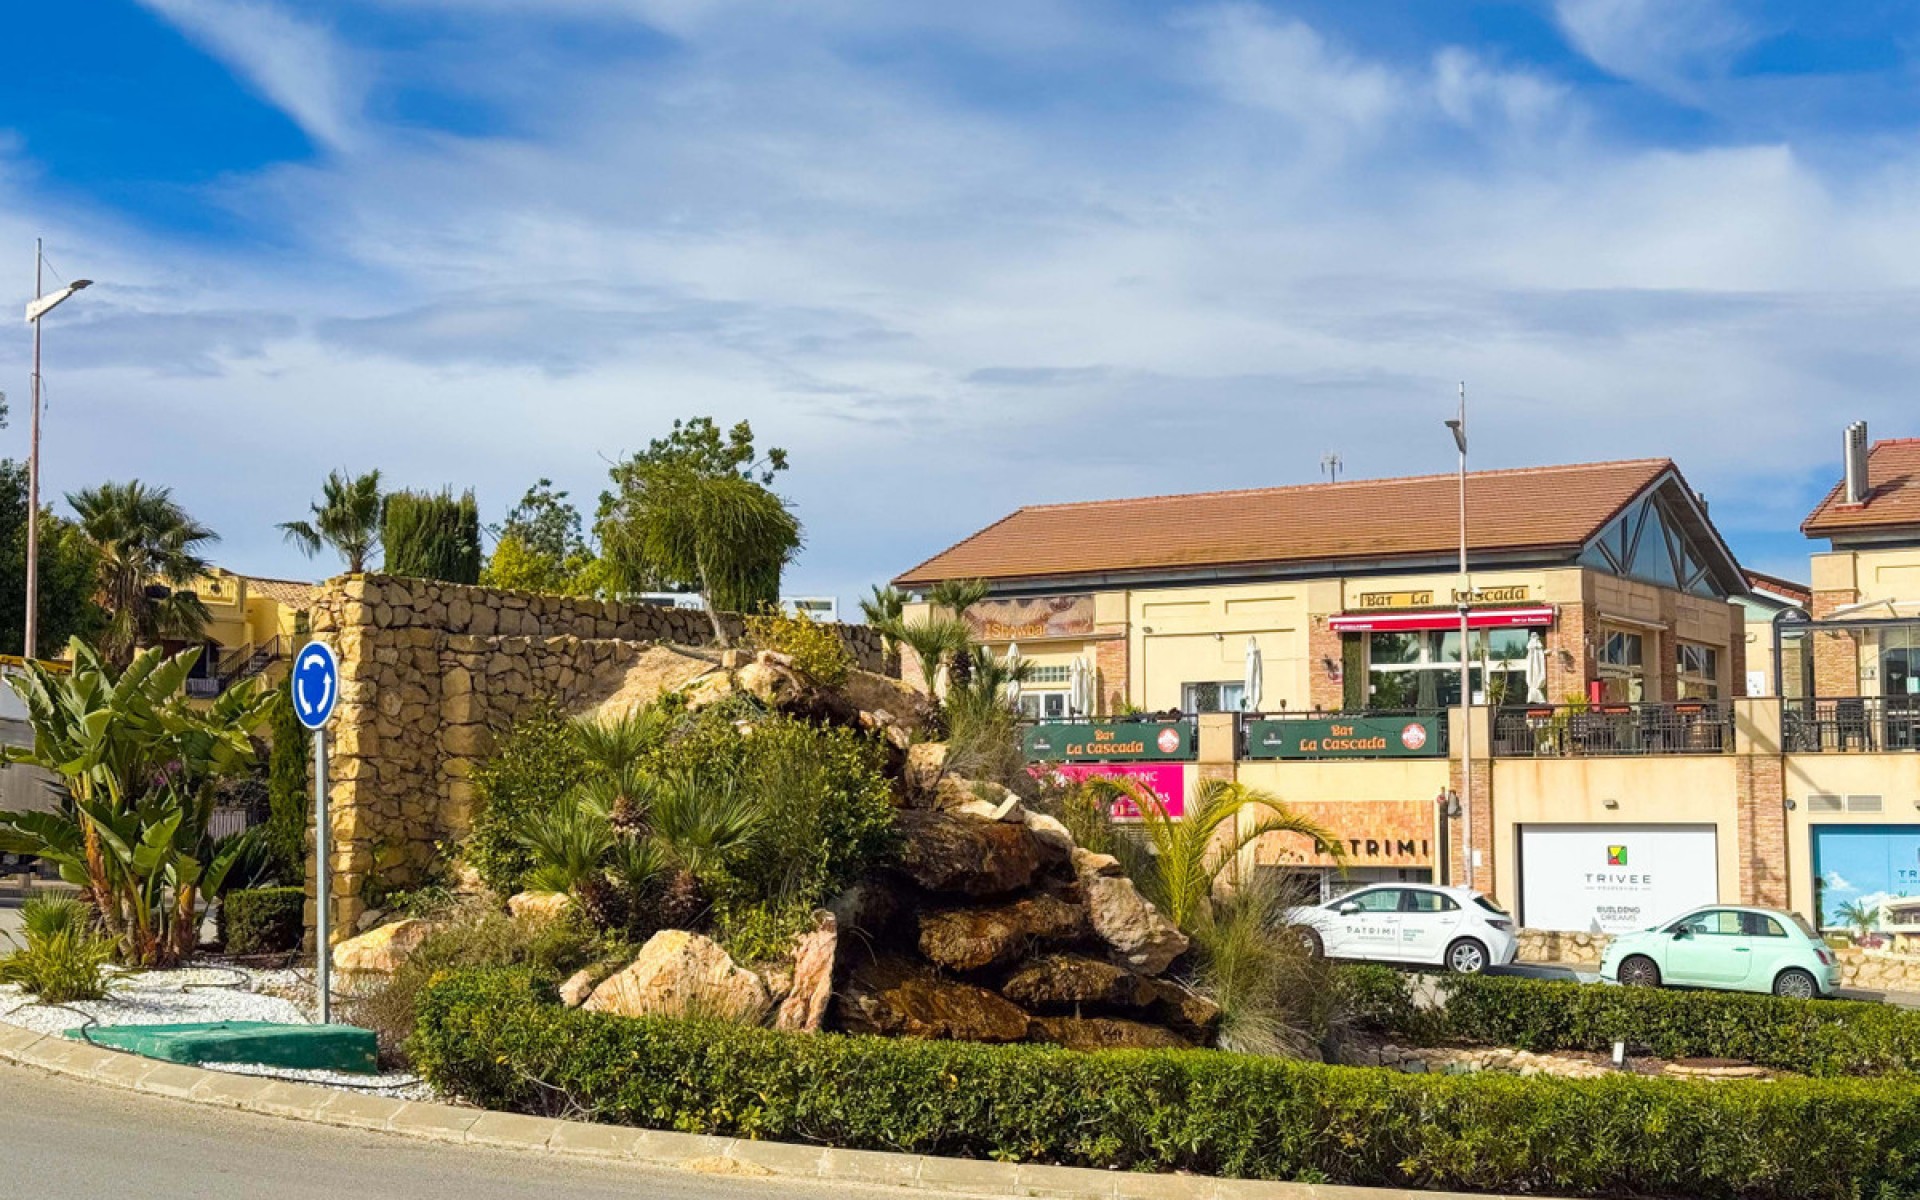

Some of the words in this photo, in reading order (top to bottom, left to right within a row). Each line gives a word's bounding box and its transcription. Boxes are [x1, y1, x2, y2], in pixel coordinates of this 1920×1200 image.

[1366, 595, 1392, 606] Bar
[1411, 593, 1430, 604] La
[1094, 729, 1114, 741] Bar
[1331, 725, 1353, 736] Bar
[1066, 743, 1082, 755] La
[1086, 741, 1144, 754] Cascada
[1300, 738, 1318, 751] La
[1322, 736, 1386, 750] Cascada
[1314, 839, 1428, 857] PATRIMI
[1585, 873, 1652, 884] TRIVEE
